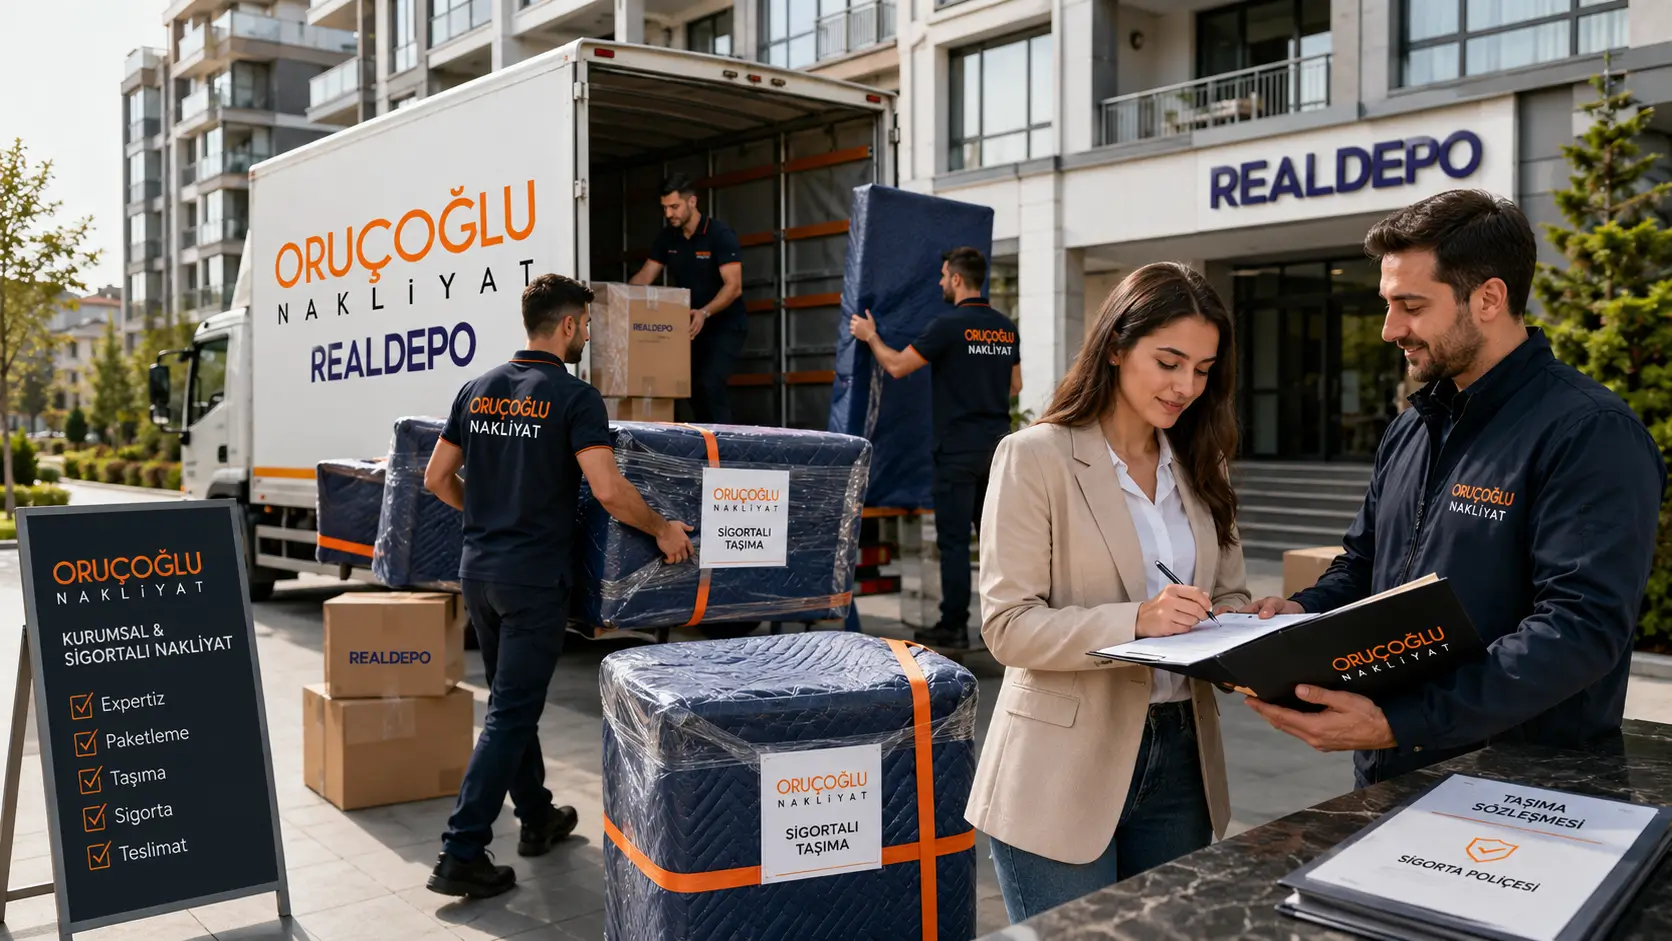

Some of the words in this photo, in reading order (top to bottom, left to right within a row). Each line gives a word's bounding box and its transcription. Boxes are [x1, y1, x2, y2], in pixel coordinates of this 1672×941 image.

[1210, 130, 1483, 209] REALDEPO
[275, 179, 536, 289] ORUÇOĞLU
[633, 323, 673, 332] REALDEPO
[310, 321, 477, 383] REALDEPO
[469, 396, 551, 420] ORUÇOĞLU
[713, 487, 779, 504] ORUÇOĞLU
[1451, 483, 1515, 507] ORUÇOĞLU
[717, 526, 771, 537] SİGORTALI
[725, 540, 764, 551] TAŞIMA
[52, 549, 201, 585] ORUÇOĞLU
[61, 624, 149, 646] KURUMSAL
[153, 623, 165, 637] &
[64, 644, 150, 667] SİGORTALI
[155, 634, 233, 657] NAKLİYAT
[349, 651, 432, 665] REALDEPO
[1332, 626, 1445, 671] ORUÇOĞLU
[101, 691, 166, 713] Expertiz
[106, 728, 190, 749] Paketleme
[110, 767, 167, 787] Taşıma
[776, 770, 868, 795] ORUÇOĞLU
[114, 803, 174, 826] Sigorta
[1503, 794, 1567, 813] TAŞIMA
[1472, 802, 1586, 830] SÖZLEŞMESİ
[785, 821, 859, 840] SİGORTALI
[118, 837, 188, 862] Teslimat
[796, 838, 850, 857] TAŞIMA
[1397, 855, 1463, 876] SİGORTA
[1465, 869, 1541, 893] POLİÇESİ
